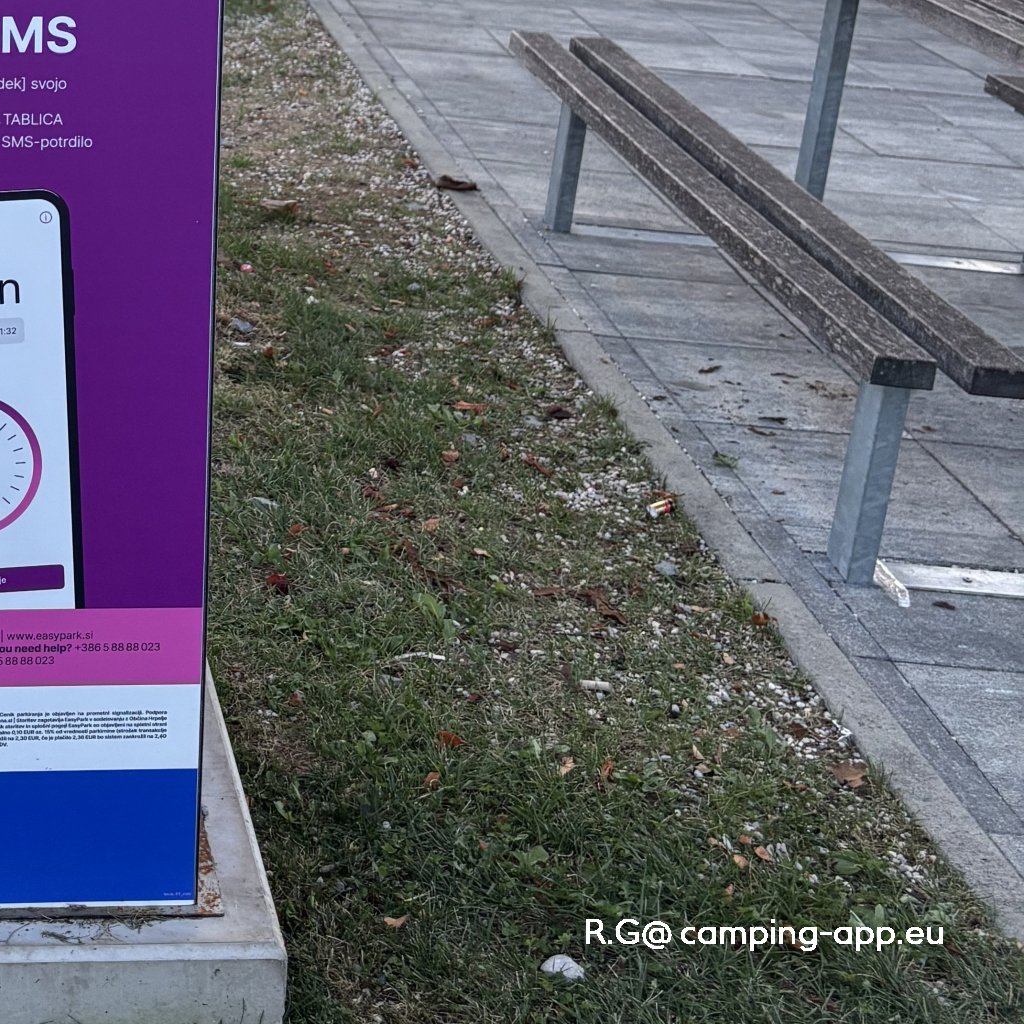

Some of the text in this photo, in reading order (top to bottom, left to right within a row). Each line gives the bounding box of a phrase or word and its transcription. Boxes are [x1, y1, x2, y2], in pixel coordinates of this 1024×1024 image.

[31, 78, 67, 92] svojo
[3, 113, 63, 126] TABLICA
[1, 135, 93, 151] SMS-potrdilo
[6, 631, 93, 642] www.easypark.si
[14, 643, 41, 653] need
[43, 643, 72, 655] help?
